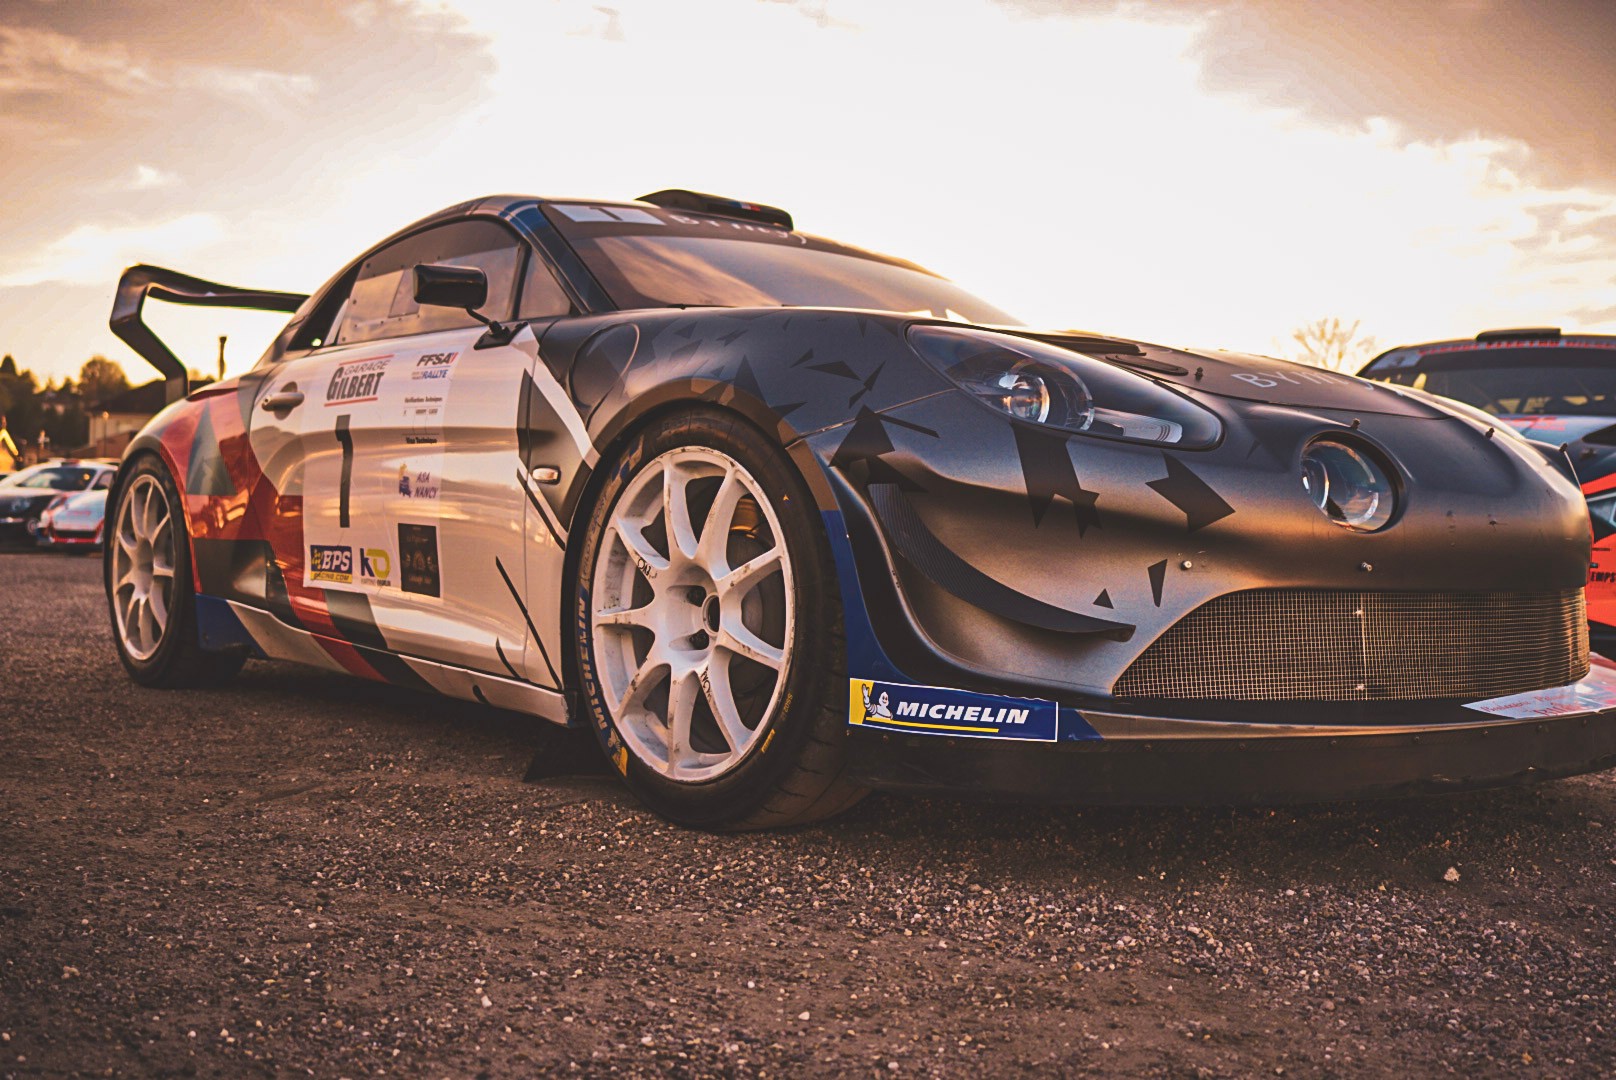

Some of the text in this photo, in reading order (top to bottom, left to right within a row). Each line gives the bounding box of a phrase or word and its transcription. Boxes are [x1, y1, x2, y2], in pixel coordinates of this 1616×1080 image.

[344, 359, 390, 376] GARAGE
[416, 352, 453, 367] FFSA
[326, 366, 385, 401] GILBERT
[335, 414, 354, 528] 1
[416, 471, 431, 483] ASA
[414, 486, 439, 499] NANCY
[321, 550, 351, 572] BPS
[577, 596, 608, 731] MICHELIN
[896, 701, 1029, 725] MICHELIN
